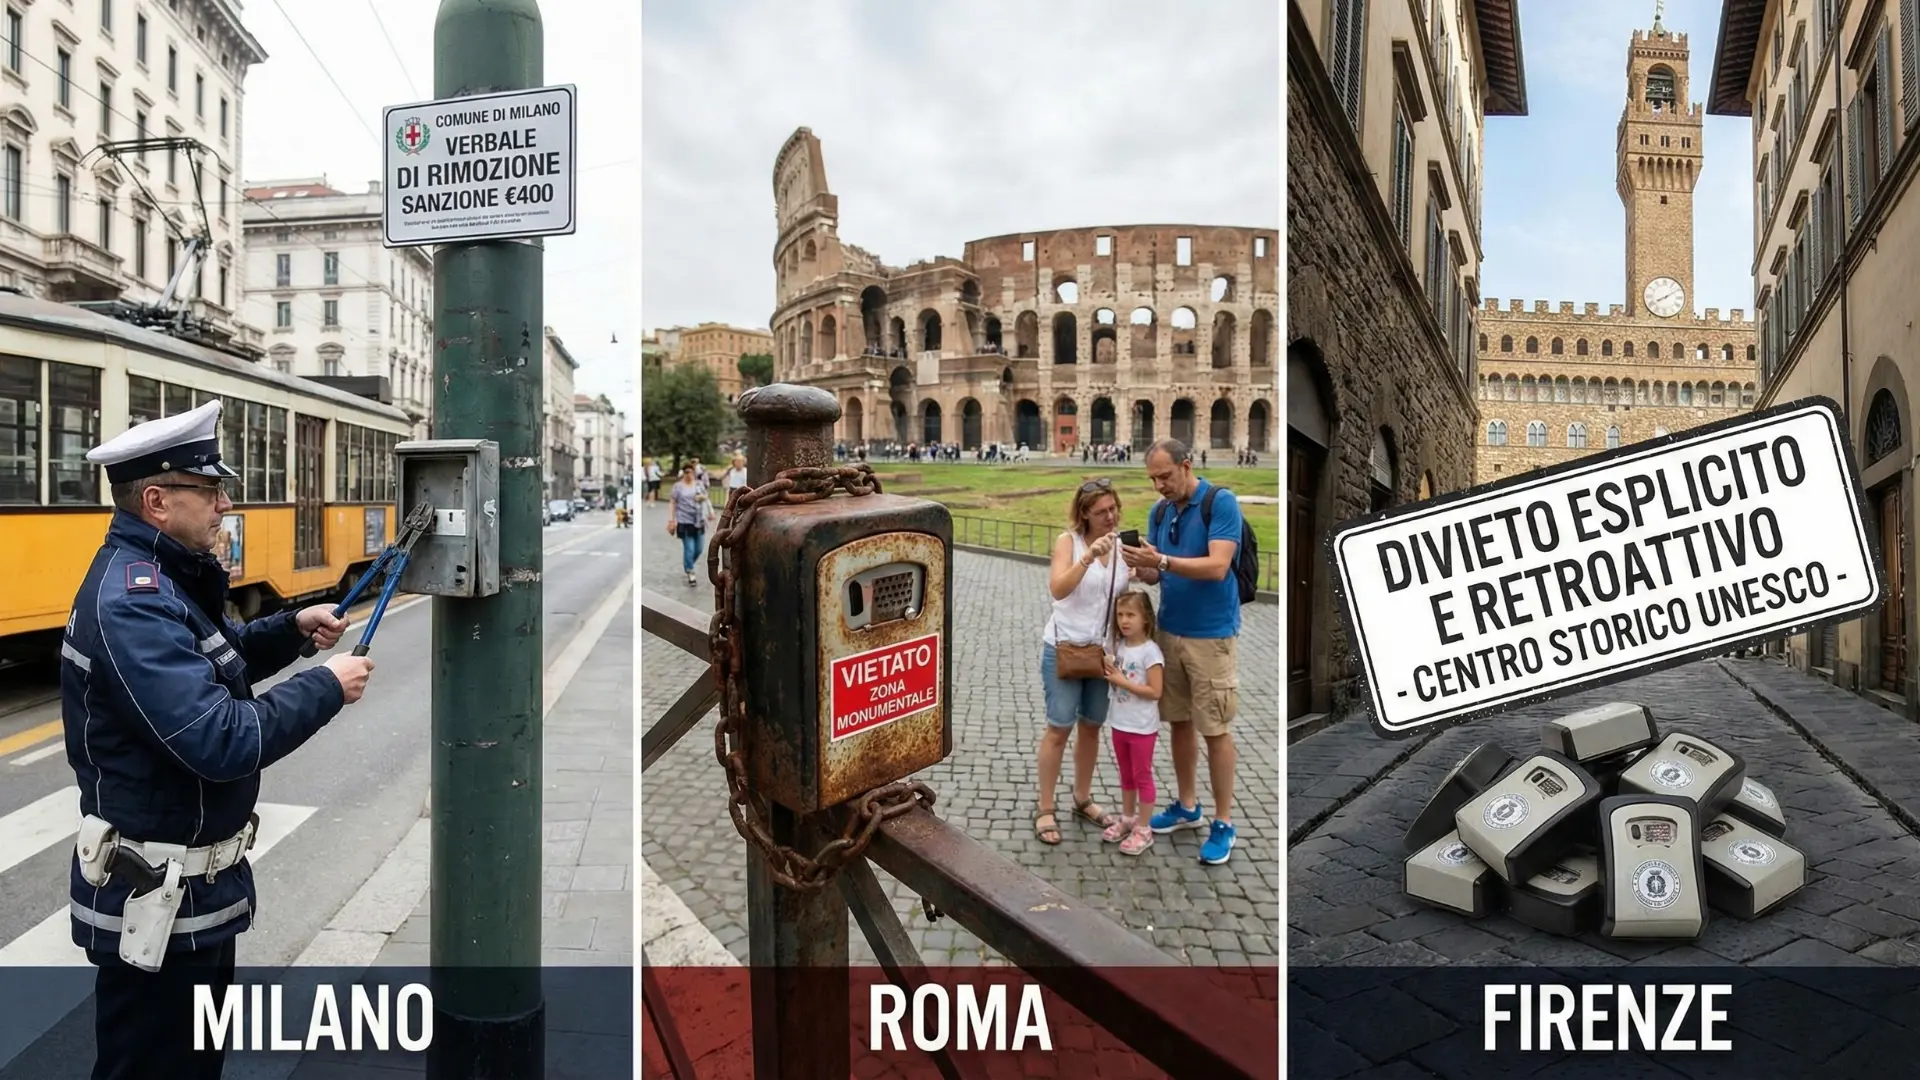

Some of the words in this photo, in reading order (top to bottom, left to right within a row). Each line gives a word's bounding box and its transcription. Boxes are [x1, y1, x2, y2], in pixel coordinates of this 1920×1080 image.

[435, 109, 489, 128] COMUNE
[493, 108, 506, 122] DI
[510, 101, 561, 120] MILANO
[445, 128, 537, 156] VERBALE
[397, 165, 419, 189] DI
[428, 151, 561, 187] RIMOZIONE
[401, 188, 499, 214] SANZIONE
[505, 183, 554, 206] €400
[841, 644, 931, 688] VIETATO
[870, 679, 905, 702] ZONA
[837, 686, 934, 730] MONUMENTALE
